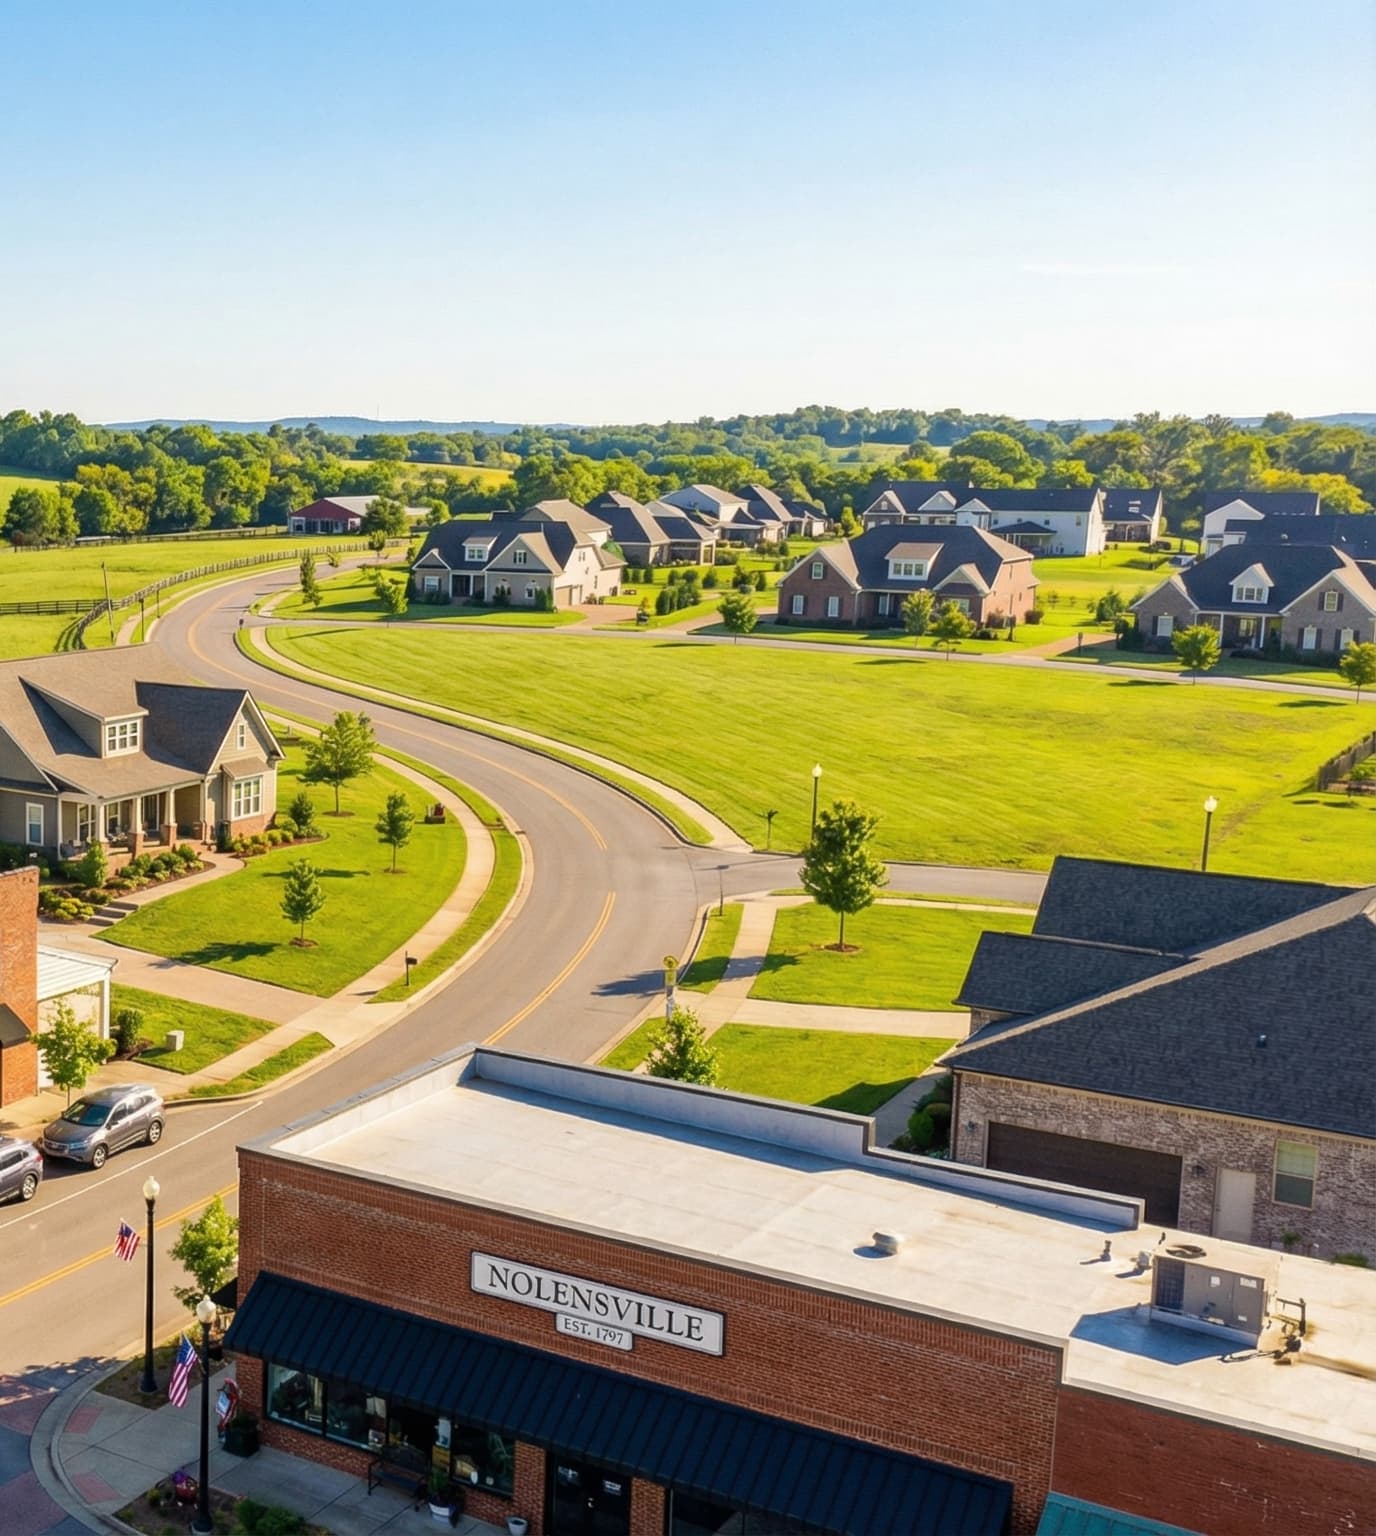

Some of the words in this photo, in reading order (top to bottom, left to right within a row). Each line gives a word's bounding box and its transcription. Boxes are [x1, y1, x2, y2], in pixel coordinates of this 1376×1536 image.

[487, 1263, 704, 1342] NOLENSVILLE
[564, 1317, 591, 1336] EST.
[596, 1327, 624, 1345] 1797
